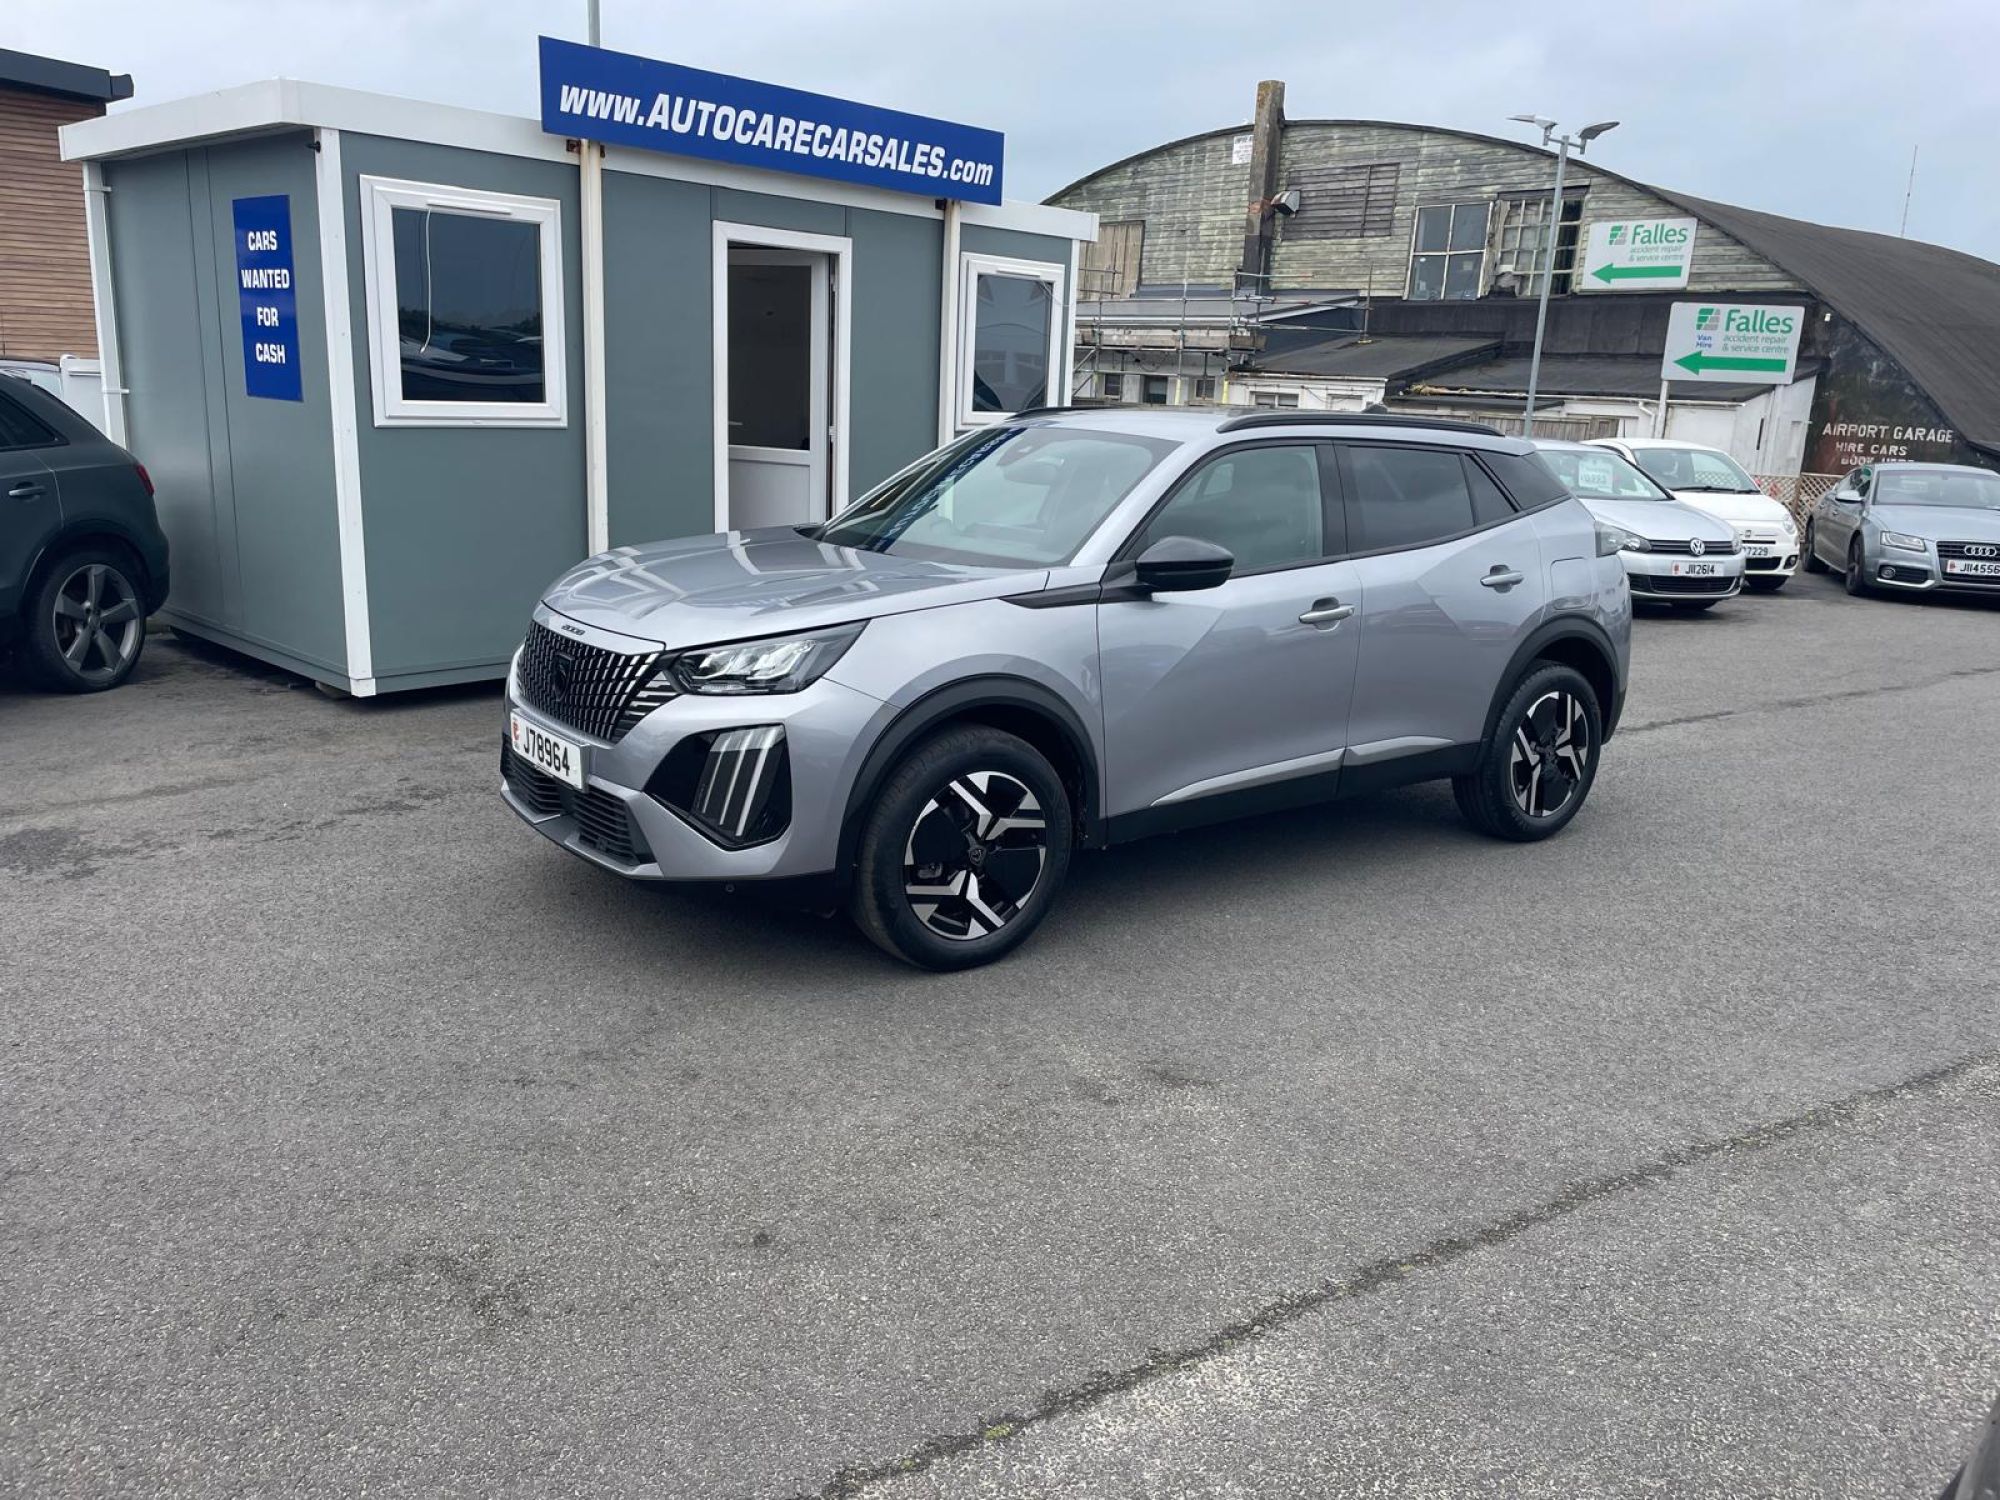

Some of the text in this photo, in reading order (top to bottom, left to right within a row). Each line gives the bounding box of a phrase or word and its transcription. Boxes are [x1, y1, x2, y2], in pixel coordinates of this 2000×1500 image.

[560, 84, 994, 187] www.AUTOCARECARSALES.com
[248, 231, 278, 251] CARS
[1631, 224, 1688, 245] Falles
[241, 269, 290, 289] WANTED
[256, 307, 279, 327] FOR
[1725, 310, 1793, 334] Falles
[1723, 335, 1787, 346] accident repair
[1762, 346, 1789, 354] centre
[255, 343, 286, 364] CASH
[1822, 422, 1954, 443] AIRPORT GARAGE
[1835, 442, 1908, 456] HIRE CARS
[523, 726, 570, 777] J78964
